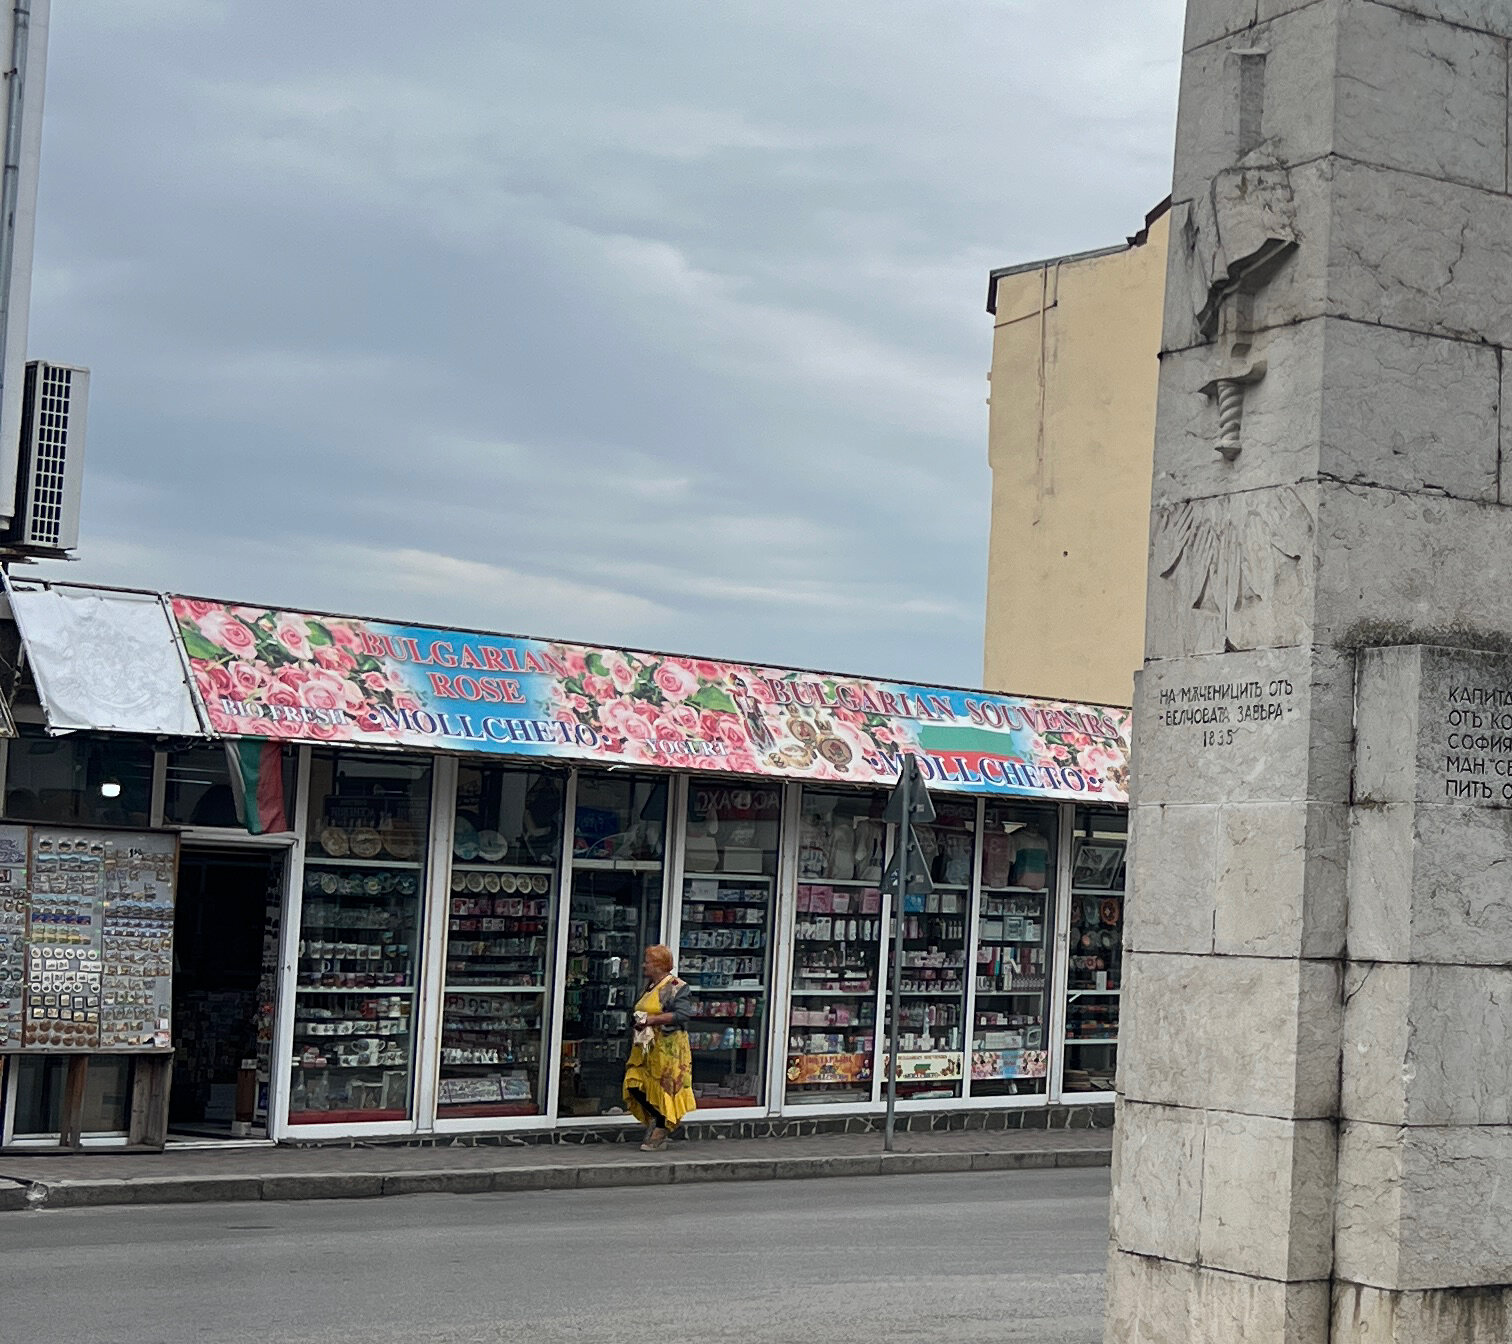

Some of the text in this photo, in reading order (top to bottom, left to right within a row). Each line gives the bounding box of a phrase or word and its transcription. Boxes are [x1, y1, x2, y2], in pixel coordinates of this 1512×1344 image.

[360, 631, 569, 679] BULGARIAN
[427, 672, 526, 704] ROSE
[1160, 688, 1176, 704] НА
[221, 698, 350, 725] BIO FRESH
[767, 677, 1119, 740] BULGARIAN SOUVENIRS
[1449, 709, 1483, 728] ОТЪ
[378, 704, 602, 750] MOLLCHETO
[645, 737, 729, 757] YOGURT
[1203, 729, 1233, 747] 1835
[1448, 733, 1512, 754] СОФИЯ
[1445, 779, 1493, 800] ПИТЪ
